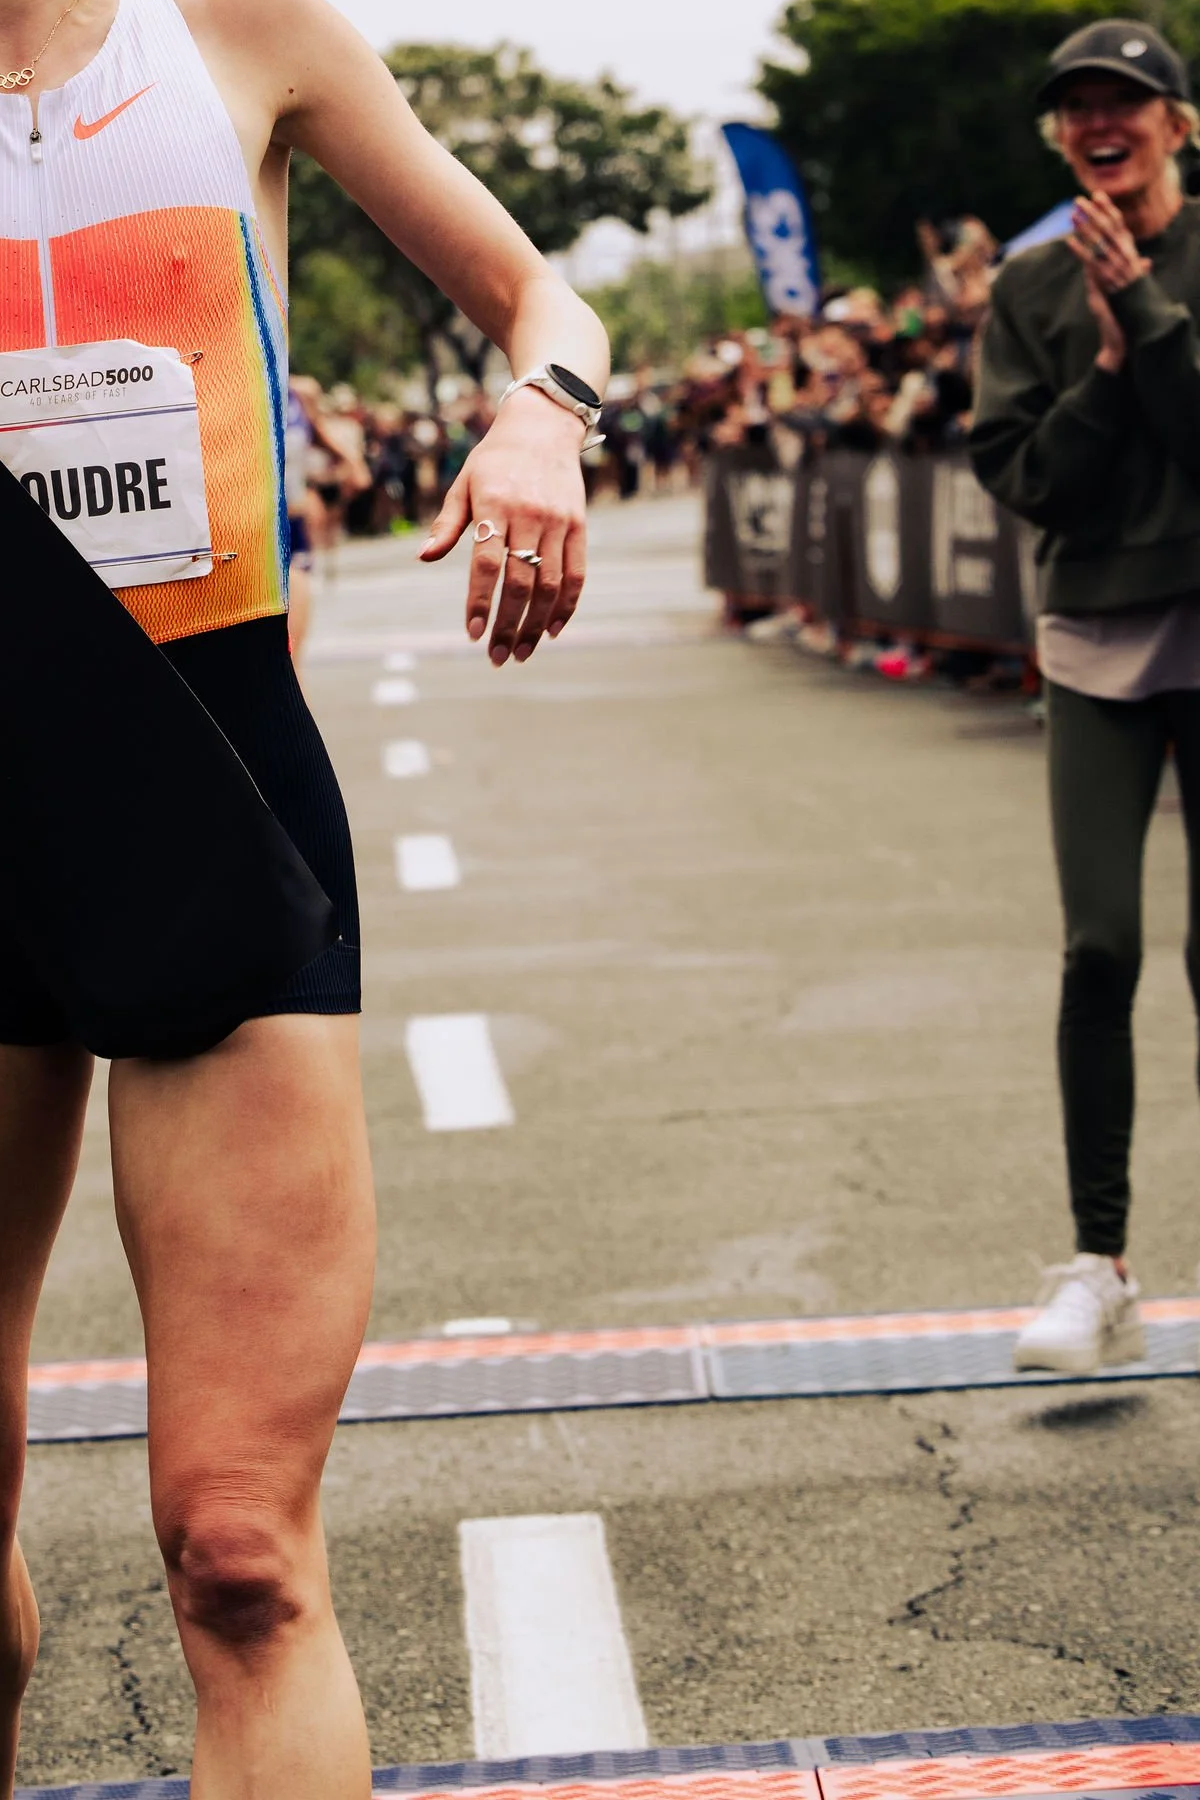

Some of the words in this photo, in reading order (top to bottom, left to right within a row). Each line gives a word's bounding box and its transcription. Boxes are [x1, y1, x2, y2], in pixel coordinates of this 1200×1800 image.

[0, 365, 154, 398] CARLSBAD5000
[29, 393, 42, 407] 40
[48, 391, 80, 406] YEARS
[85, 389, 96, 401] OF
[103, 387, 128, 399] FAST
